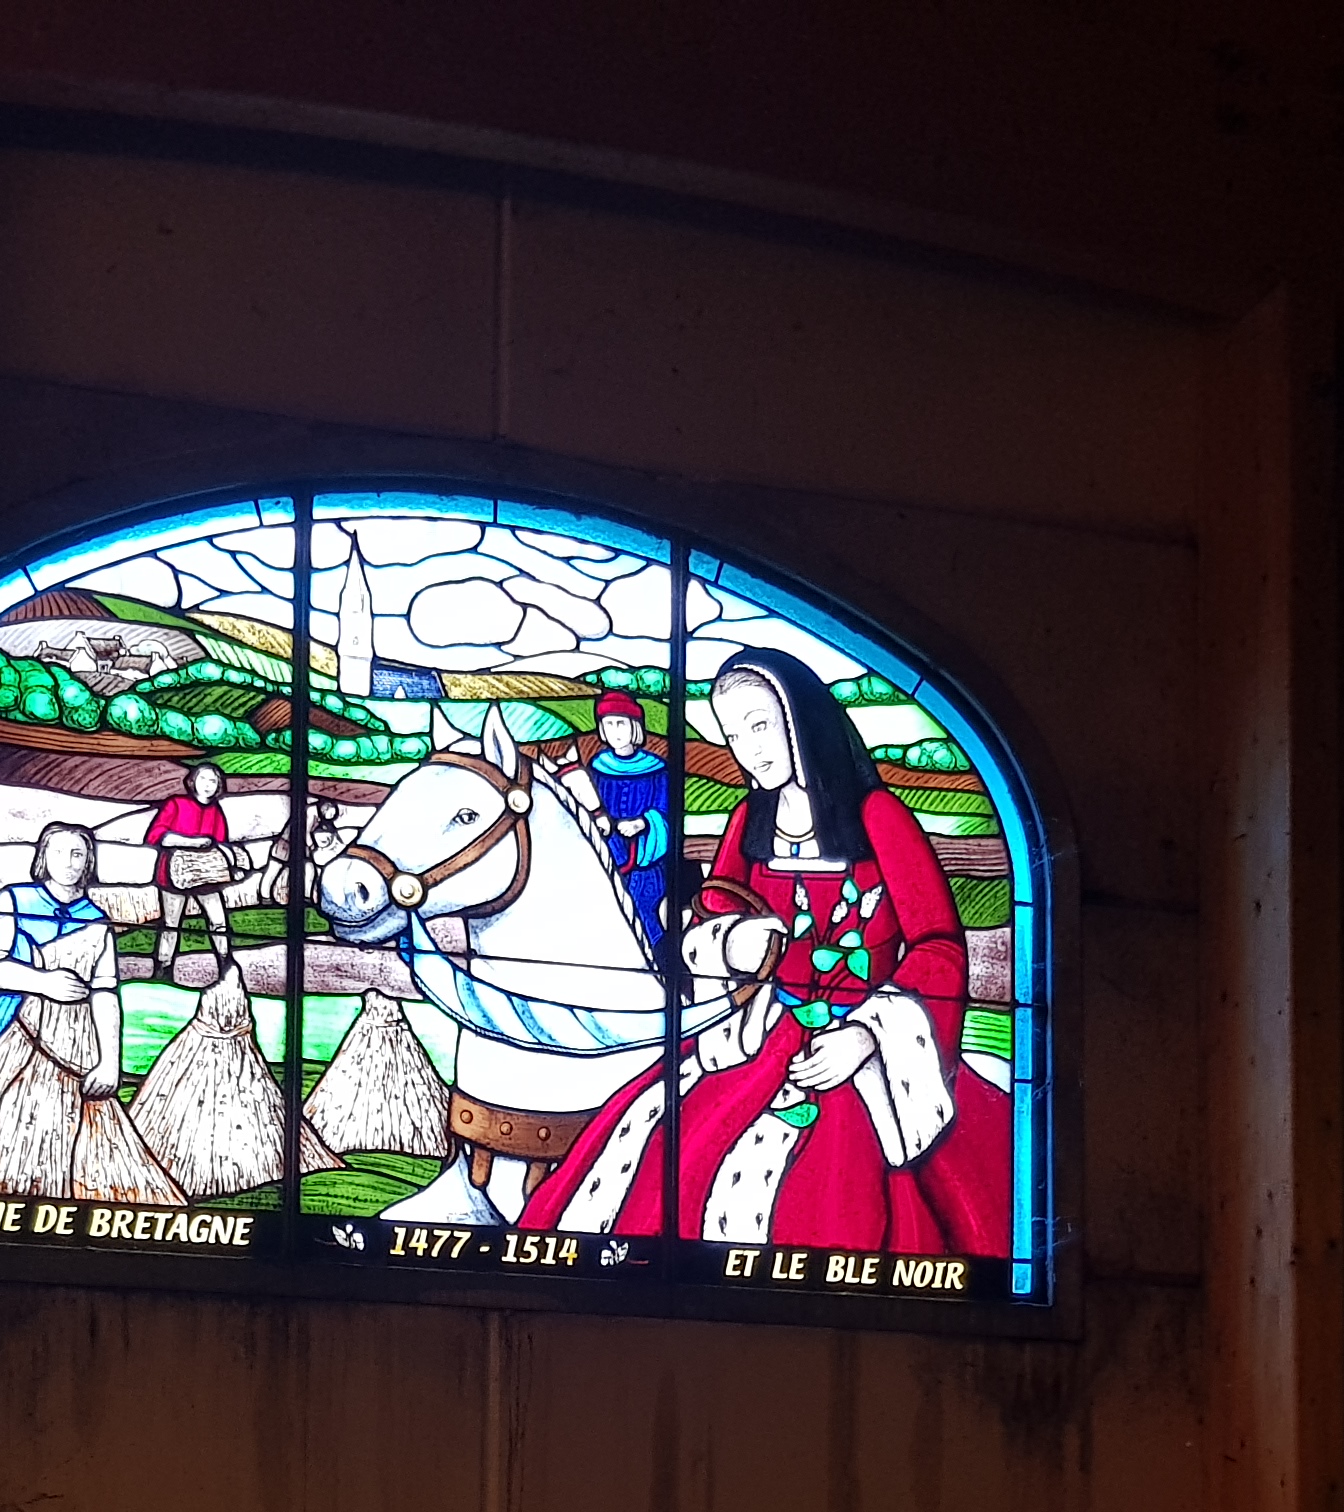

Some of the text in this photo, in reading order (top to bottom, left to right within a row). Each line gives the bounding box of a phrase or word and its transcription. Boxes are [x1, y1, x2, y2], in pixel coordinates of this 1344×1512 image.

[33, 1204, 78, 1235] DE
[88, 1208, 254, 1246] BRETAGNE
[389, 1226, 472, 1259] 1477
[501, 1234, 579, 1266] 1514
[725, 1249, 966, 1290] ET LE BLE NOIR
